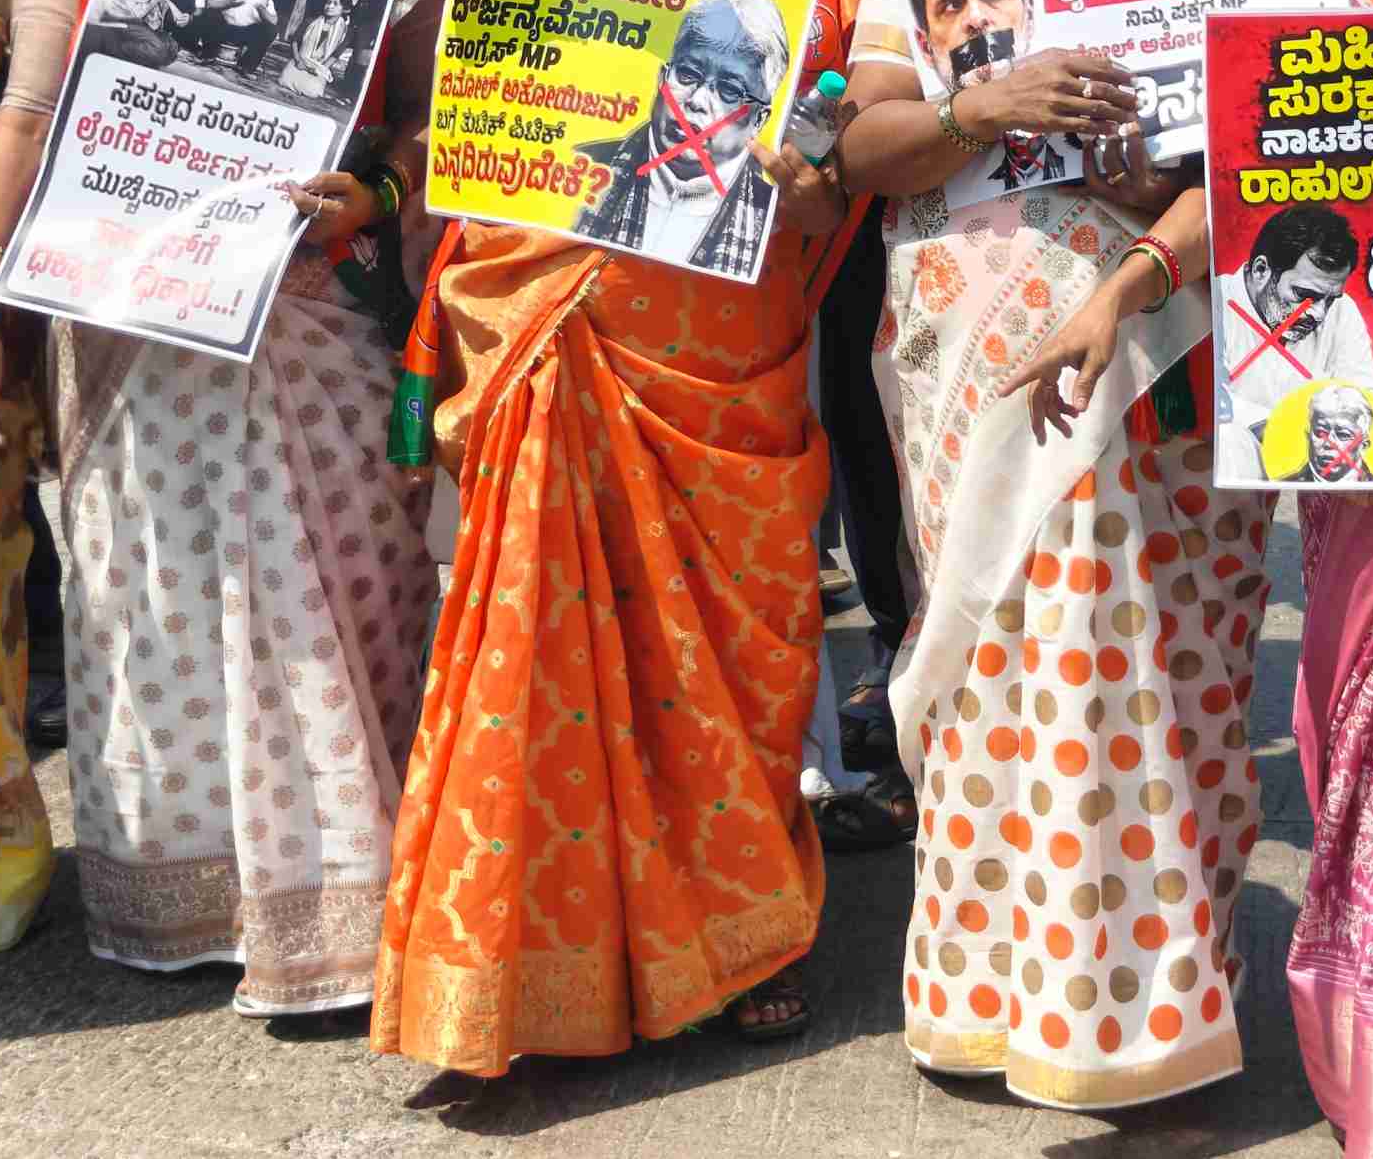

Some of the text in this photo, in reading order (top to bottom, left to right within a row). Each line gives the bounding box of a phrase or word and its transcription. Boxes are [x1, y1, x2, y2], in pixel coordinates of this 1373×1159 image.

[520, 42, 562, 70] MP
[76, 111, 153, 157] ಲೈಂಗಿಕ
[109, 76, 299, 150] ಸ್ವಪಕ್ಷದ ಸಂಸದನ
